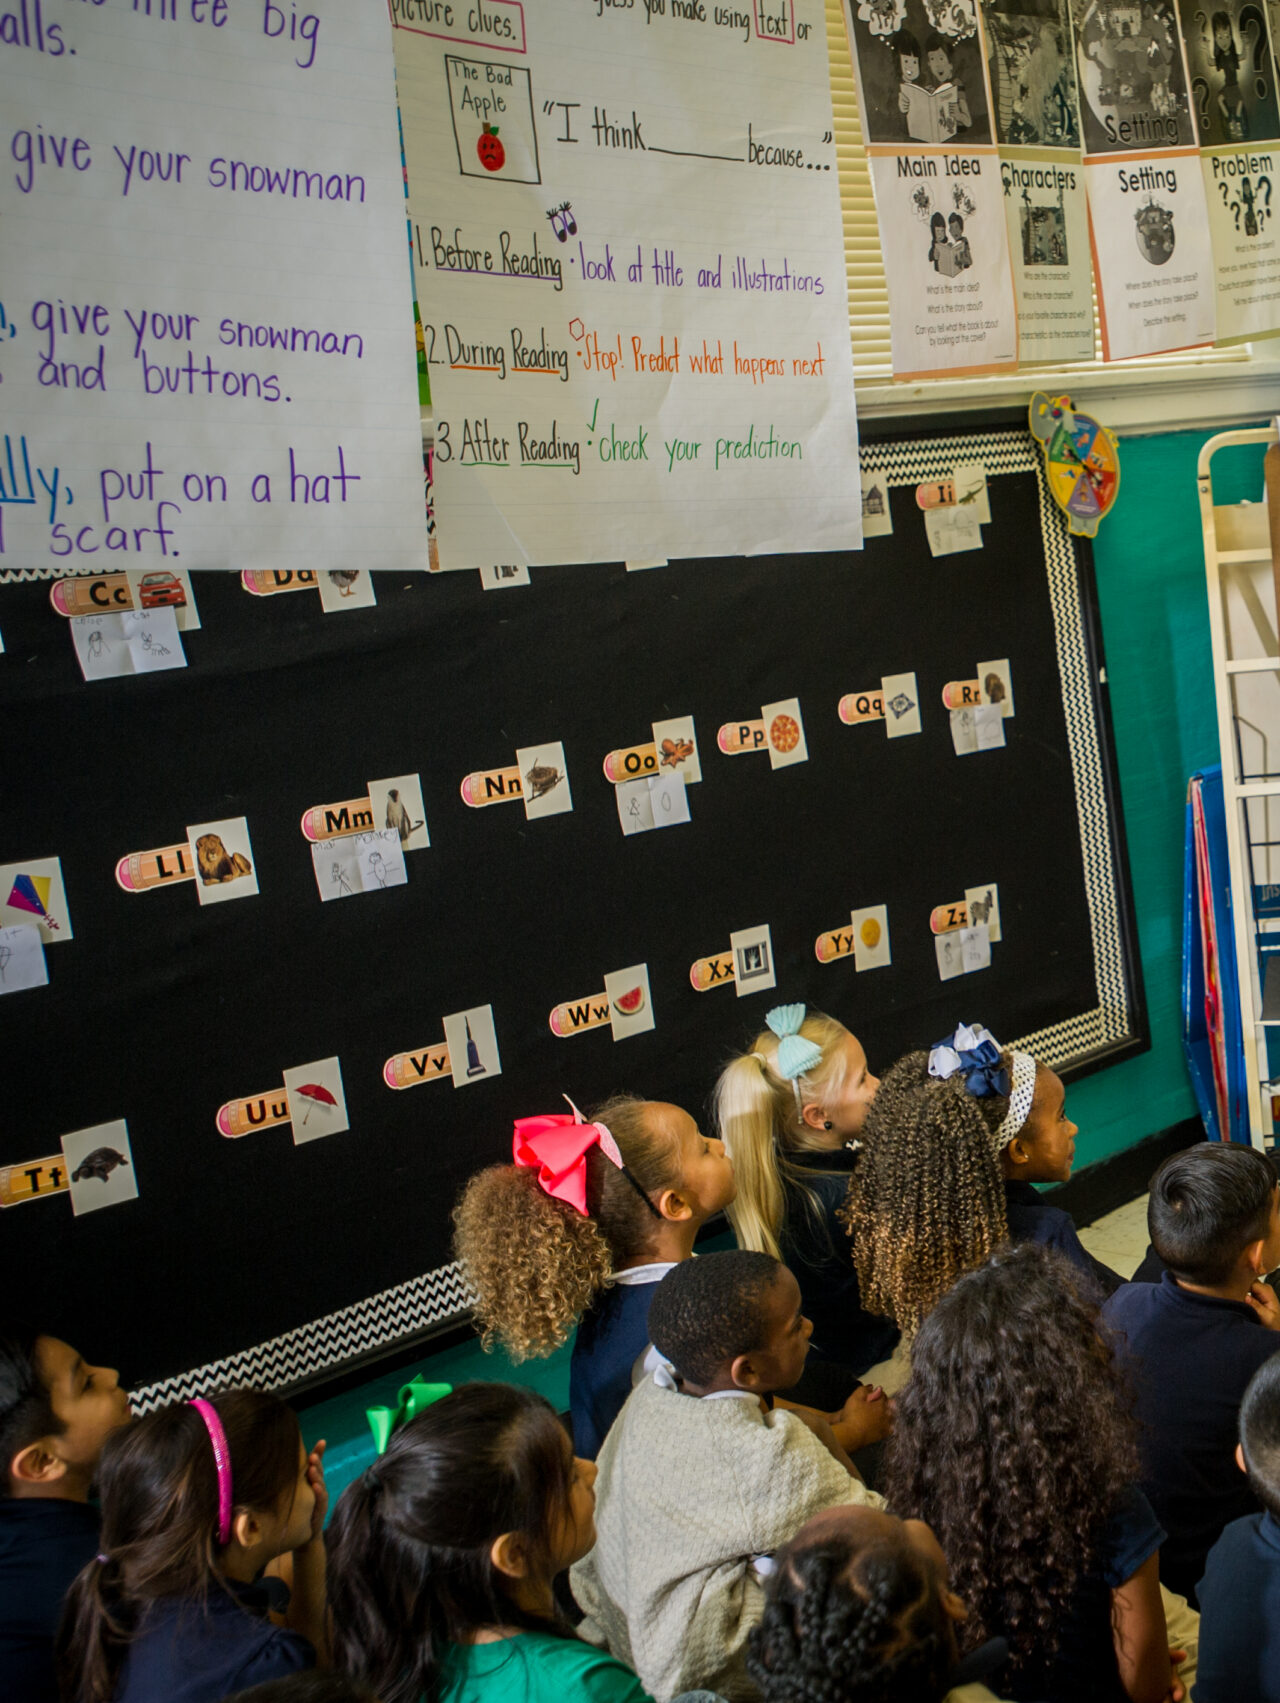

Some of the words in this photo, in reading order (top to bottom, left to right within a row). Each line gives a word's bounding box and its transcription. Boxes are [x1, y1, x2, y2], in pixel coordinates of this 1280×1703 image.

[263, 0, 320, 68] big
[468, 0, 516, 41] clues.
[714, 7, 751, 42] using
[757, 0, 788, 36] text
[796, 22, 813, 40] or
[449, 60, 479, 81] The
[485, 64, 514, 87] Bad
[460, 85, 508, 121] Apple
[591, 105, 647, 151] think
[1104, 112, 1181, 148] Setting
[11, 125, 93, 194] give
[112, 144, 192, 198] your
[208, 156, 366, 203] snowman
[897, 155, 937, 179] Main
[943, 154, 983, 179] Idea
[1000, 161, 1077, 192] Characters
[1118, 163, 1178, 194] Setting
[1211, 152, 1275, 178] Problem
[415, 226, 430, 269] 1.
[435, 229, 493, 273] Before
[499, 231, 564, 292] Reading
[577, 240, 616, 284] look
[628, 244, 645, 284] at
[652, 247, 685, 288] title
[697, 253, 723, 290] and
[731, 255, 826, 296] illustrations
[32, 300, 111, 362] give
[123, 308, 201, 360] your
[218, 317, 364, 359] snowman
[423, 324, 446, 366] 2.
[449, 325, 506, 381] During
[511, 327, 569, 383] Reading
[582, 331, 624, 382] Stop!
[631, 336, 681, 375] Predict
[689, 340, 724, 376] what
[734, 341, 786, 386] happens
[792, 342, 826, 376] next
[37, 345, 107, 392] and
[141, 349, 293, 403] buttons.
[436, 421, 456, 464] 3.
[460, 417, 510, 463] After
[519, 420, 582, 476] Reading
[599, 423, 650, 463] check
[664, 436, 703, 473] your
[714, 422, 804, 471] prediction
[100, 441, 165, 524] put
[182, 472, 228, 502] on
[251, 474, 272, 502] a
[287, 446, 362, 505] hat
[49, 501, 182, 558] scarf.
[87, 582, 129, 610] Cc
[856, 694, 885, 717] Qq
[963, 684, 980, 704] Rr
[739, 725, 765, 749] Pp
[624, 751, 657, 774] Oo
[485, 773, 522, 799] Nn
[323, 807, 375, 835] Mm
[947, 909, 967, 928] Zz
[831, 933, 854, 954] Yy
[707, 959, 735, 983] Xx
[568, 1003, 610, 1029] Ww
[409, 1052, 447, 1078] Vv
[245, 1100, 289, 1126] Uu
[24, 1165, 63, 1194] Tt
